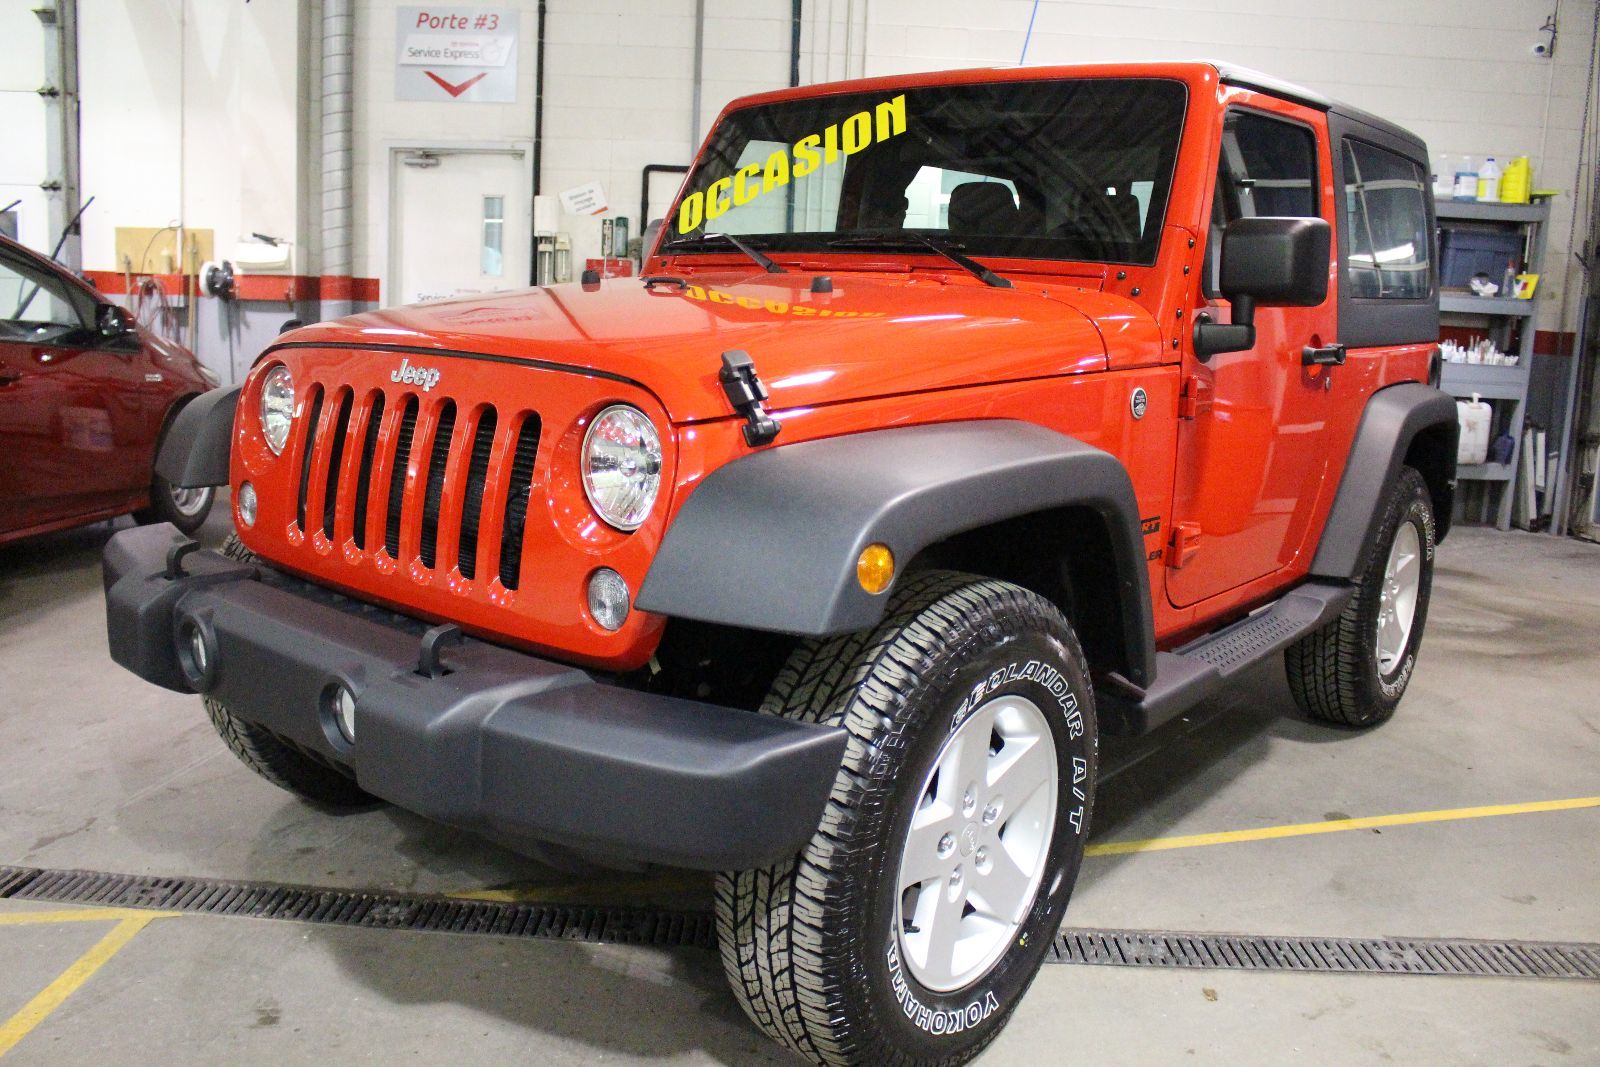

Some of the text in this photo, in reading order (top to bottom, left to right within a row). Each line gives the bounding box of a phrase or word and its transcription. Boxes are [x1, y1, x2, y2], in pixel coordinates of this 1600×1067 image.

[407, 46, 481, 60] Service Express
[416, 12, 499, 31] Porte #3
[678, 93, 907, 235] OCCASION
[390, 358, 440, 392] Jeep
[949, 660, 1087, 834] GEOLANDAR A/T
[886, 940, 1000, 1035] YOKOHAMA
